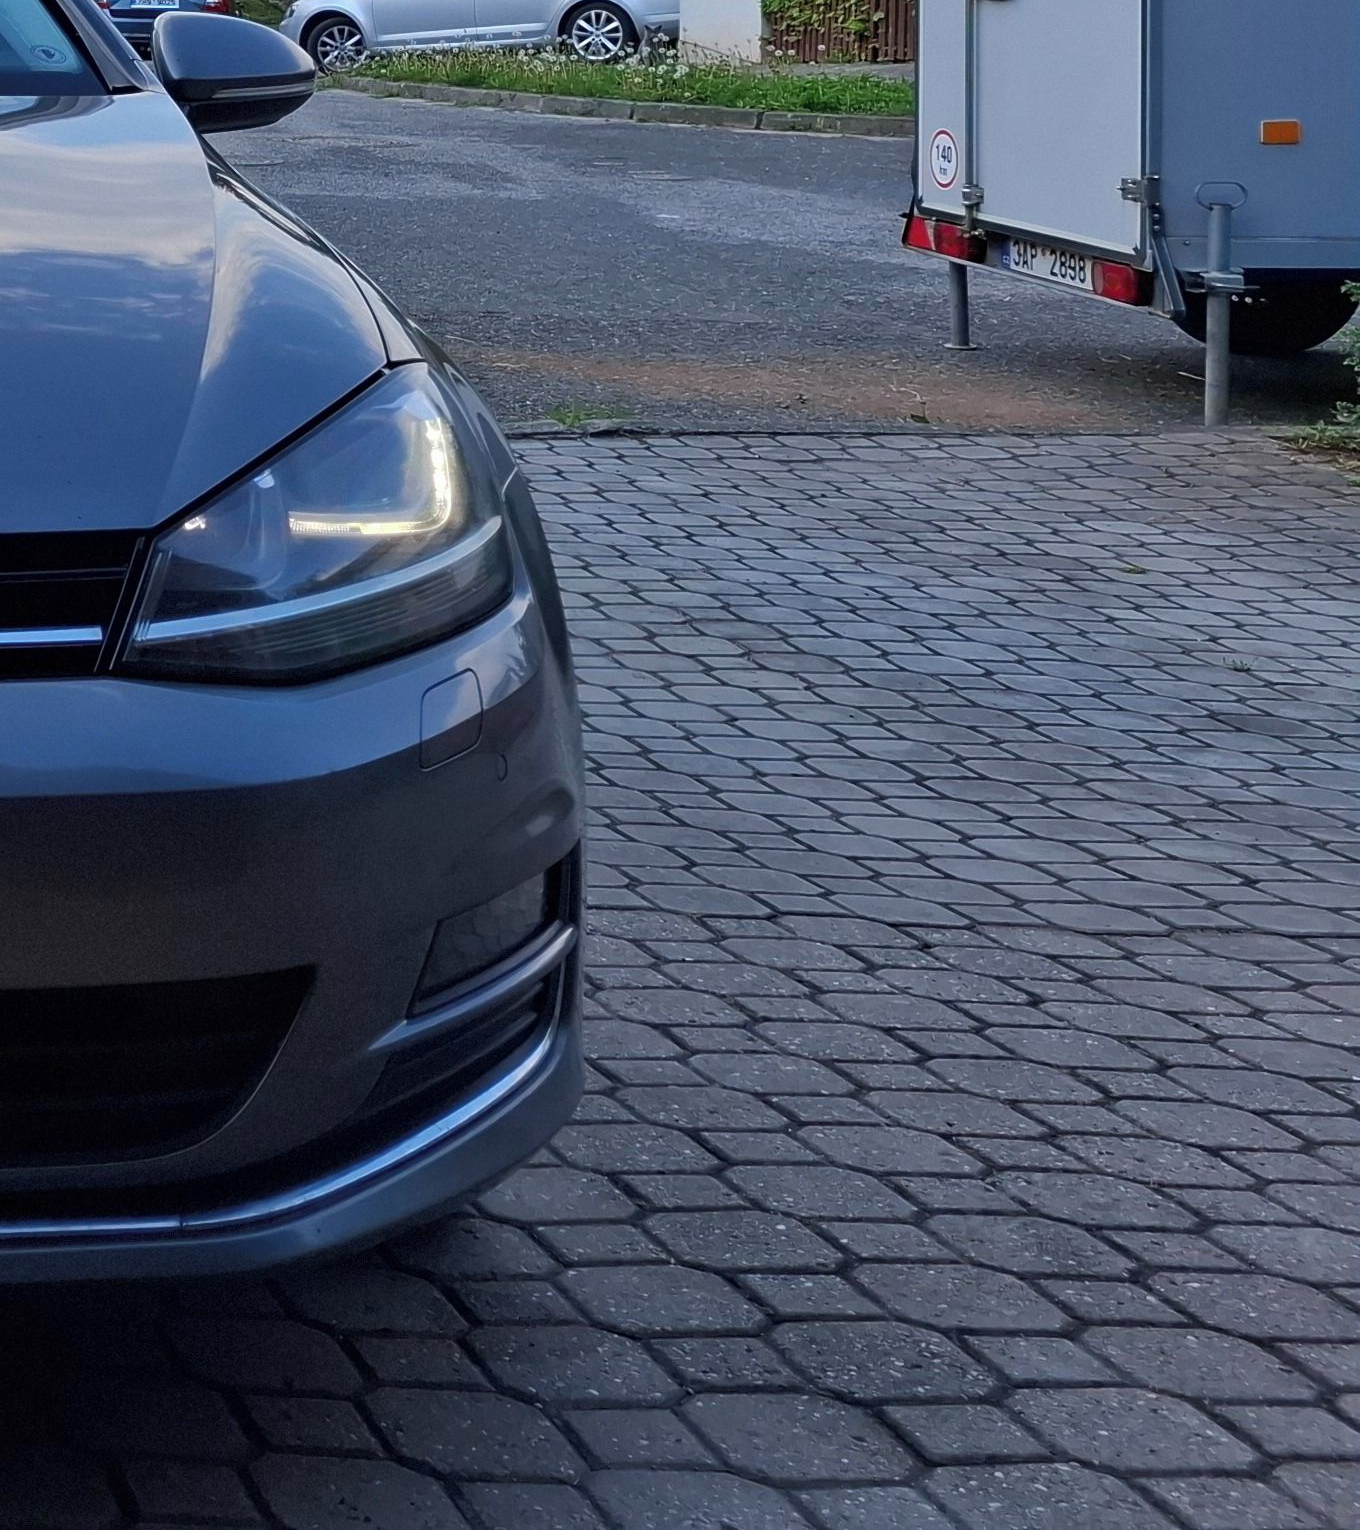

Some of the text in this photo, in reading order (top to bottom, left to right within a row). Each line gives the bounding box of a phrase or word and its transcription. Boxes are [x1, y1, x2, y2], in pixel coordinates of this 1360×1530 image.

[935, 143, 953, 164] 140
[1012, 239, 1087, 284] 3AP 2898
